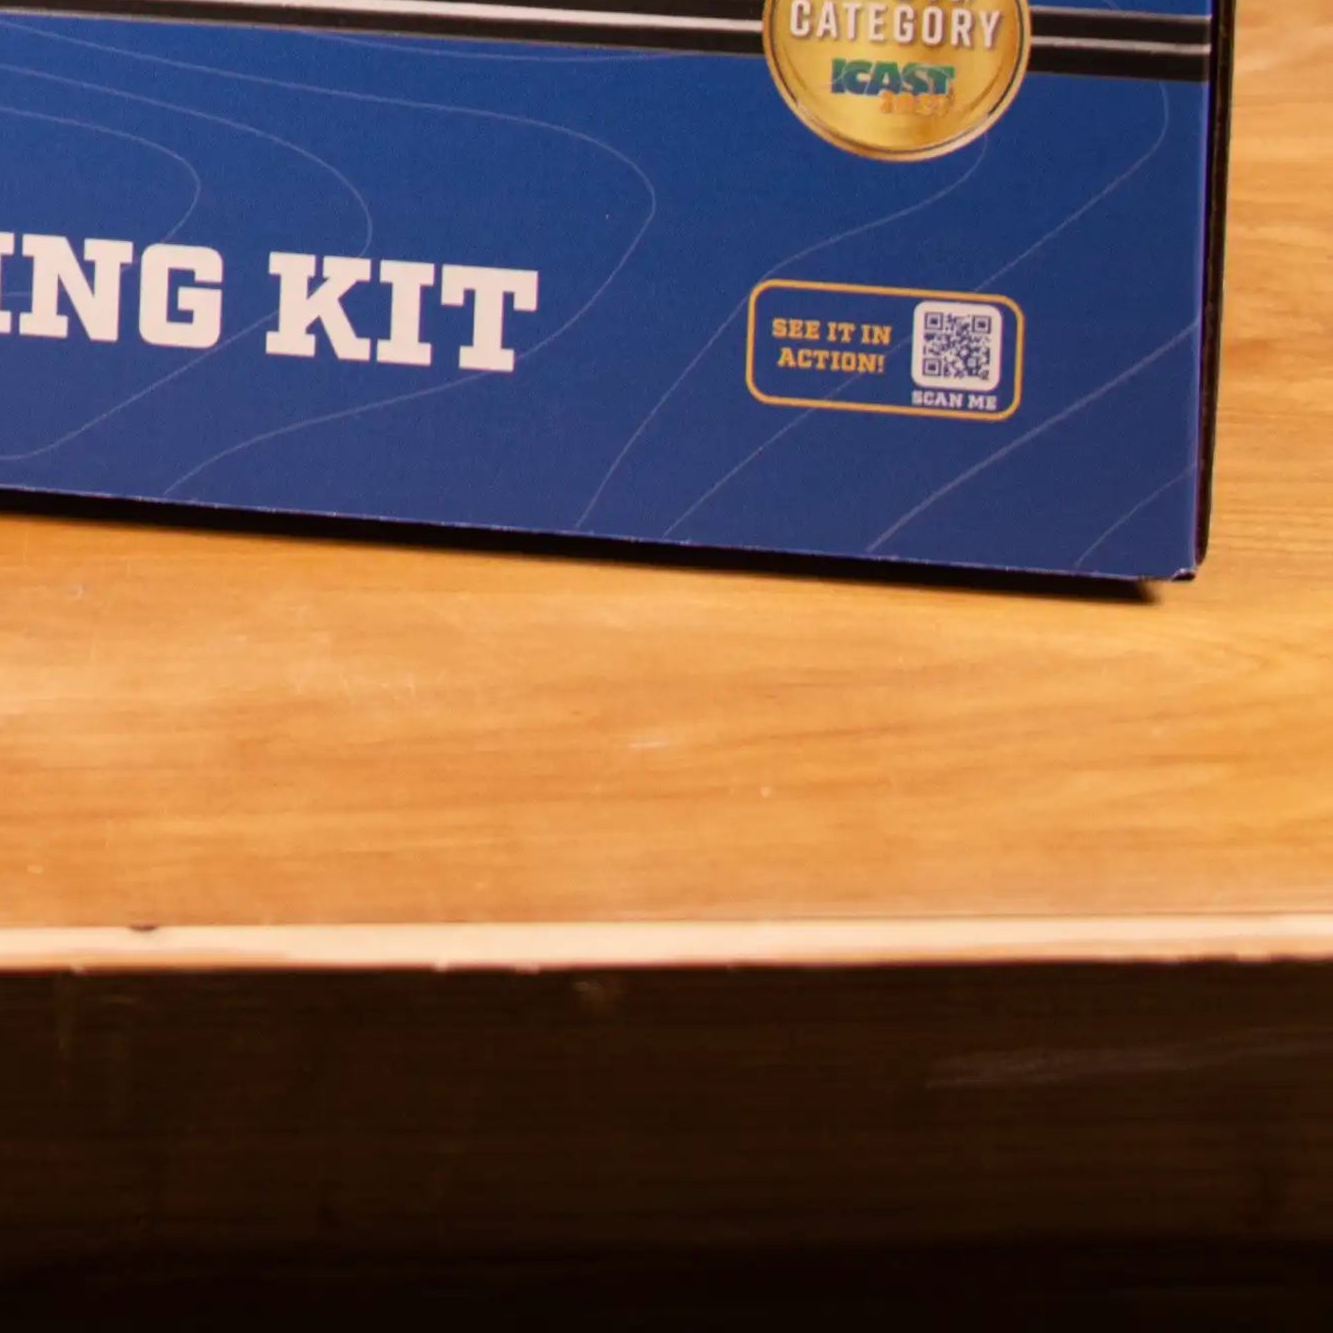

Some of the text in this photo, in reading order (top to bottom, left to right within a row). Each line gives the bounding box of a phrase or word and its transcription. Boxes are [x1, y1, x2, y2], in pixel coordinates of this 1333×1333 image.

[265, 251, 539, 372] KIT
[772, 318, 892, 346] SEE IT IN
[777, 347, 886, 374] ACTION!
[910, 389, 998, 411] SCAN ME
